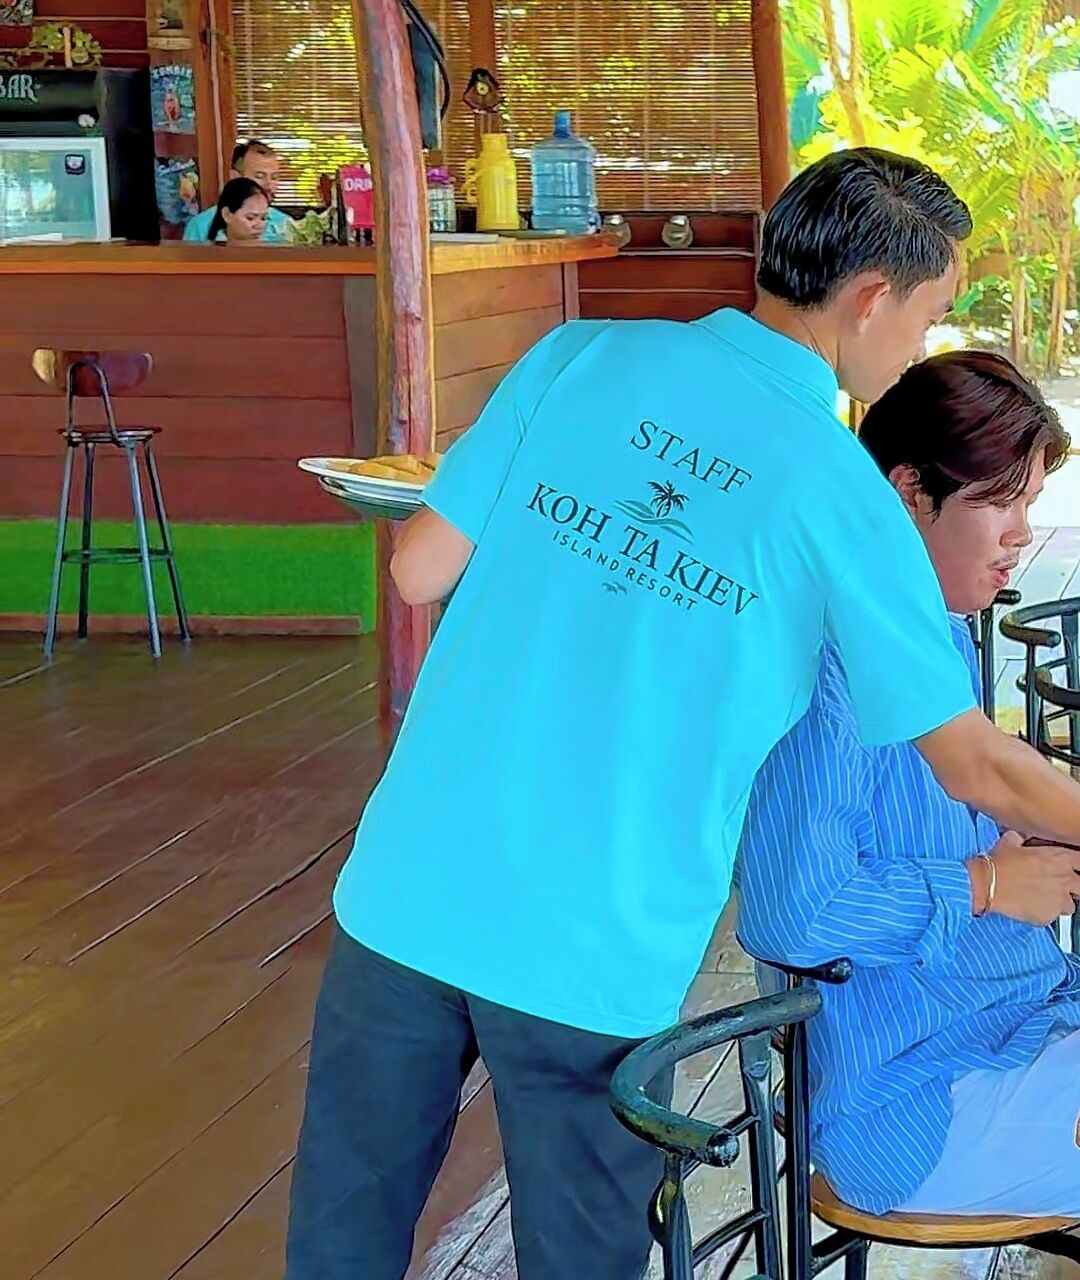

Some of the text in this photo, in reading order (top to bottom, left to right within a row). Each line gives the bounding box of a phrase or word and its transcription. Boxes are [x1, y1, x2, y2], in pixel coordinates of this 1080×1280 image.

[630, 421, 752, 493] STAFF
[526, 483, 759, 616] KOH TA KIEV
[552, 530, 698, 611] ISLAND RESORT
